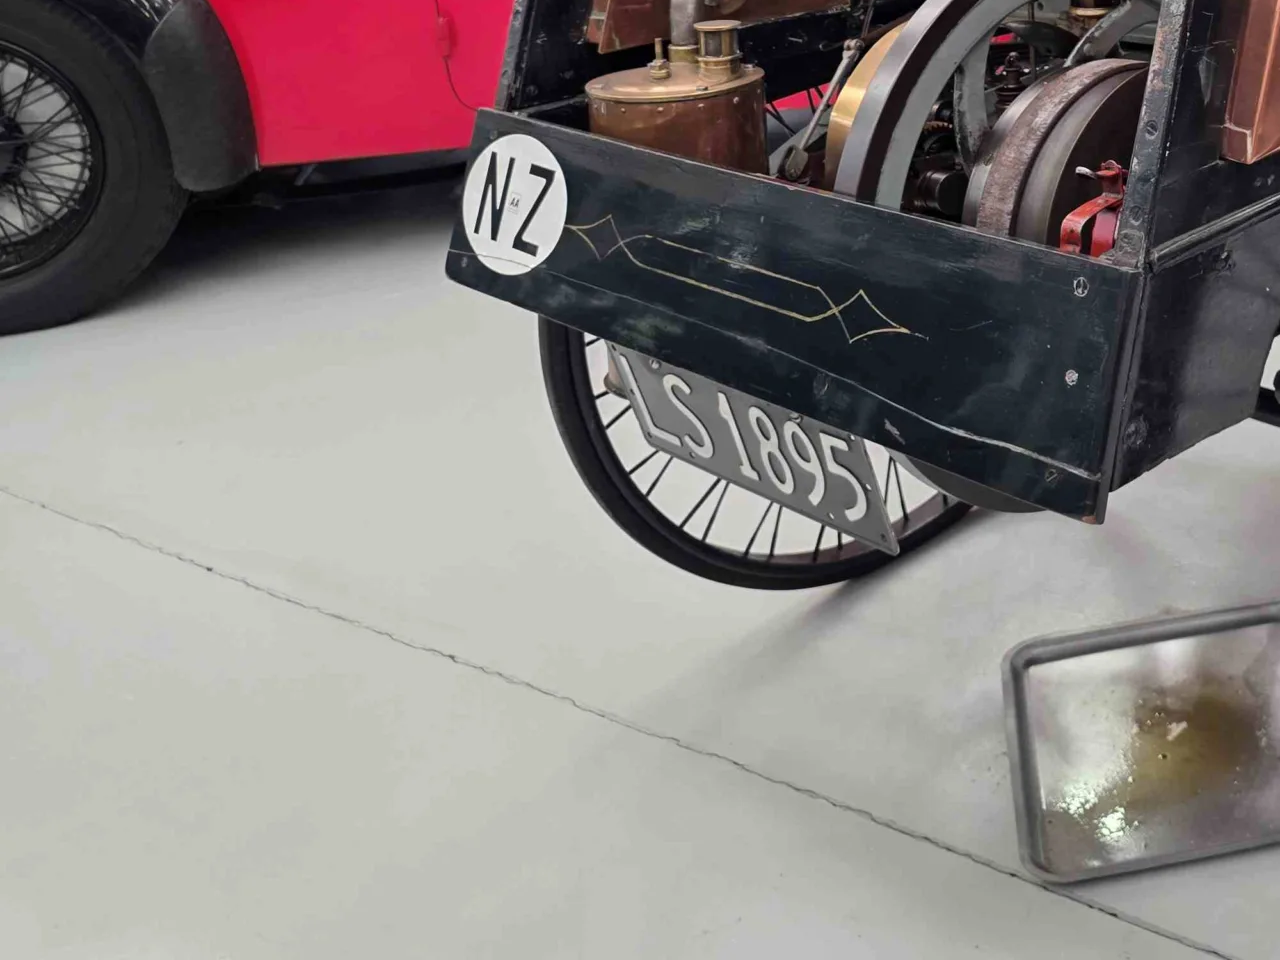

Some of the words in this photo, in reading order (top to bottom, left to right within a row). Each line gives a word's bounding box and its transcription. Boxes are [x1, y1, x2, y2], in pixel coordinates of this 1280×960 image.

[474, 151, 556, 257] NZ
[509, 197, 520, 208] AA
[619, 354, 714, 459] LS
[717, 391, 867, 522] 1895
